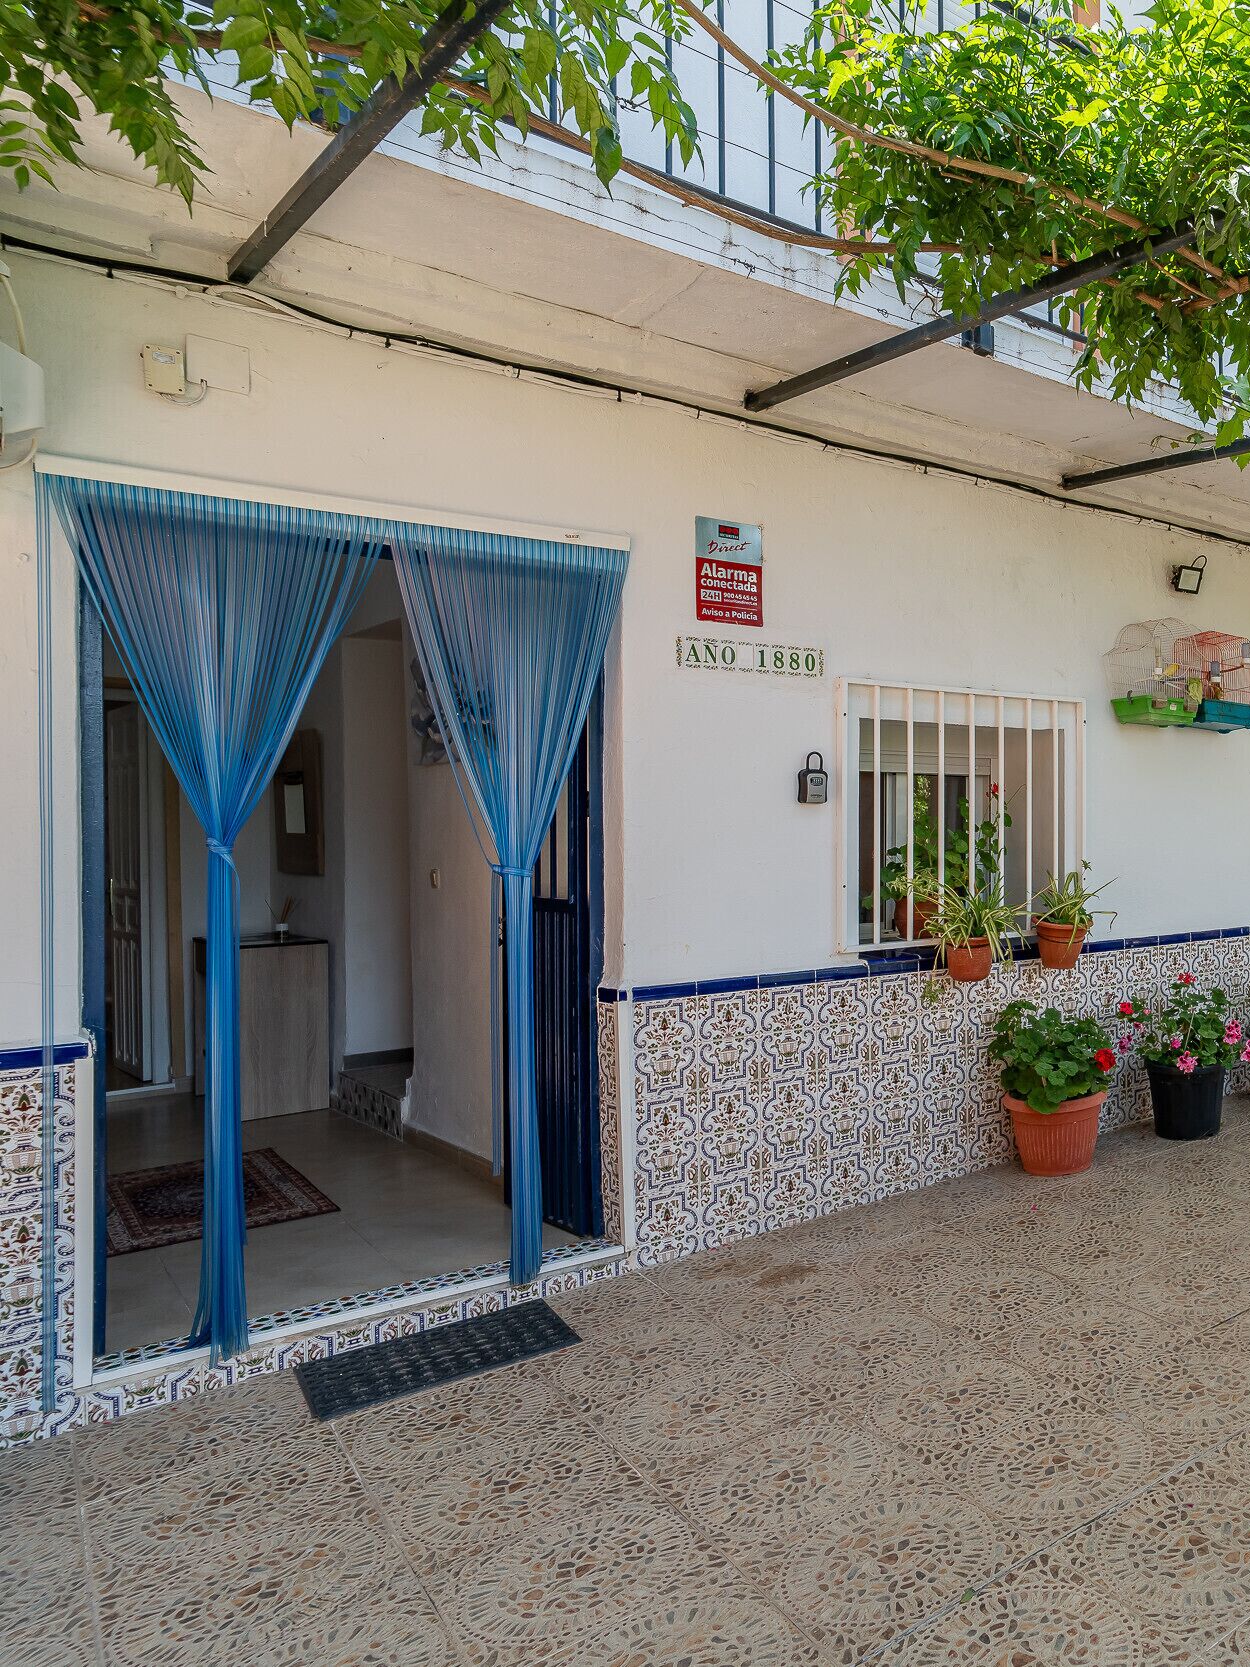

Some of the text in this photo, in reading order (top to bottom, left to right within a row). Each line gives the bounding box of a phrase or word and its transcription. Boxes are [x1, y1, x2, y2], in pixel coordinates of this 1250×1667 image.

[707, 540, 751, 554] Direct
[701, 562, 757, 583] Alarma
[701, 578, 757, 593] conectada
[702, 590, 720, 600] 24H
[702, 608, 723, 617] Aviso
[731, 611, 757, 621] Policía
[685, 641, 816, 672] AÑO 1880
